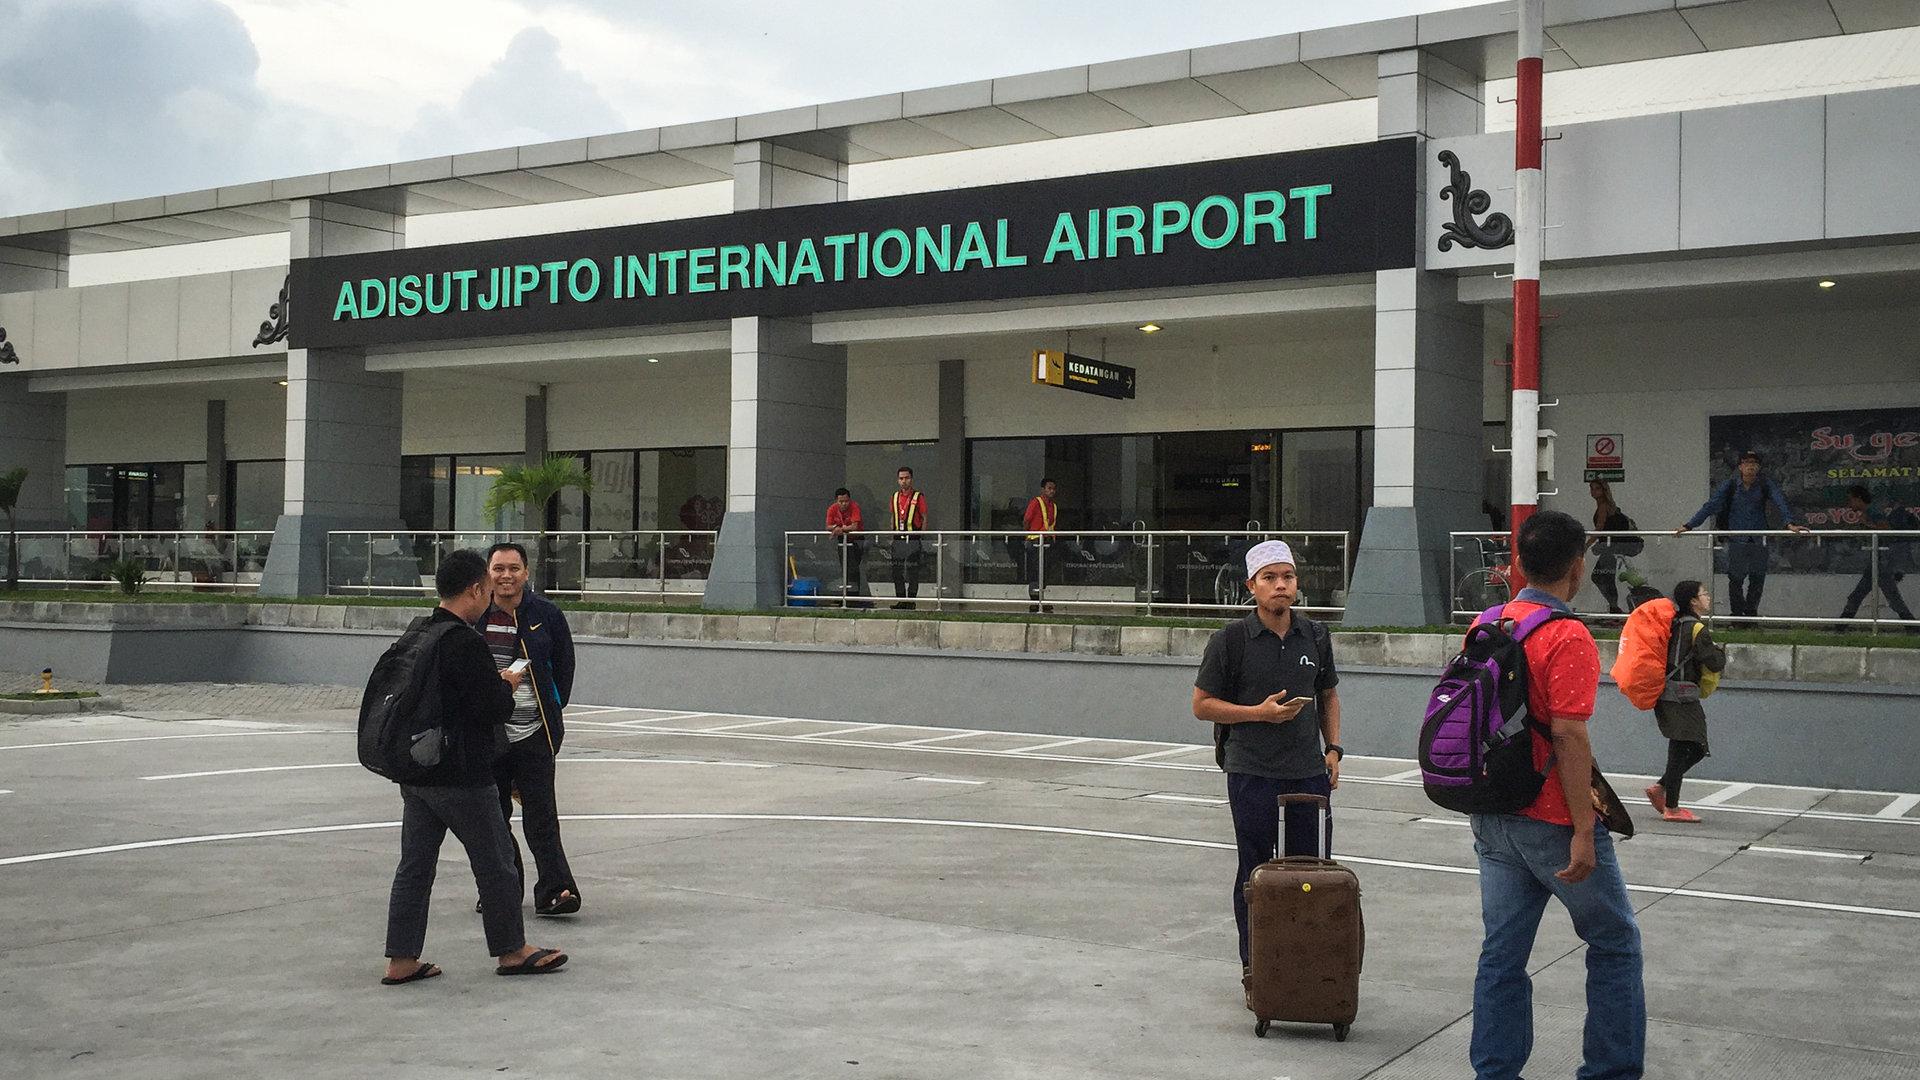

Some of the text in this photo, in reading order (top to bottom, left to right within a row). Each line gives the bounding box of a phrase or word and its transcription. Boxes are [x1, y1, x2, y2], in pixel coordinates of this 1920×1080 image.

[333, 183, 1333, 321] ADISUTJIPTO INTERNATIONAL AIRPORT
[1068, 361, 1120, 381] KEDATANGAN
[1826, 466, 1912, 479] SELAMAT
